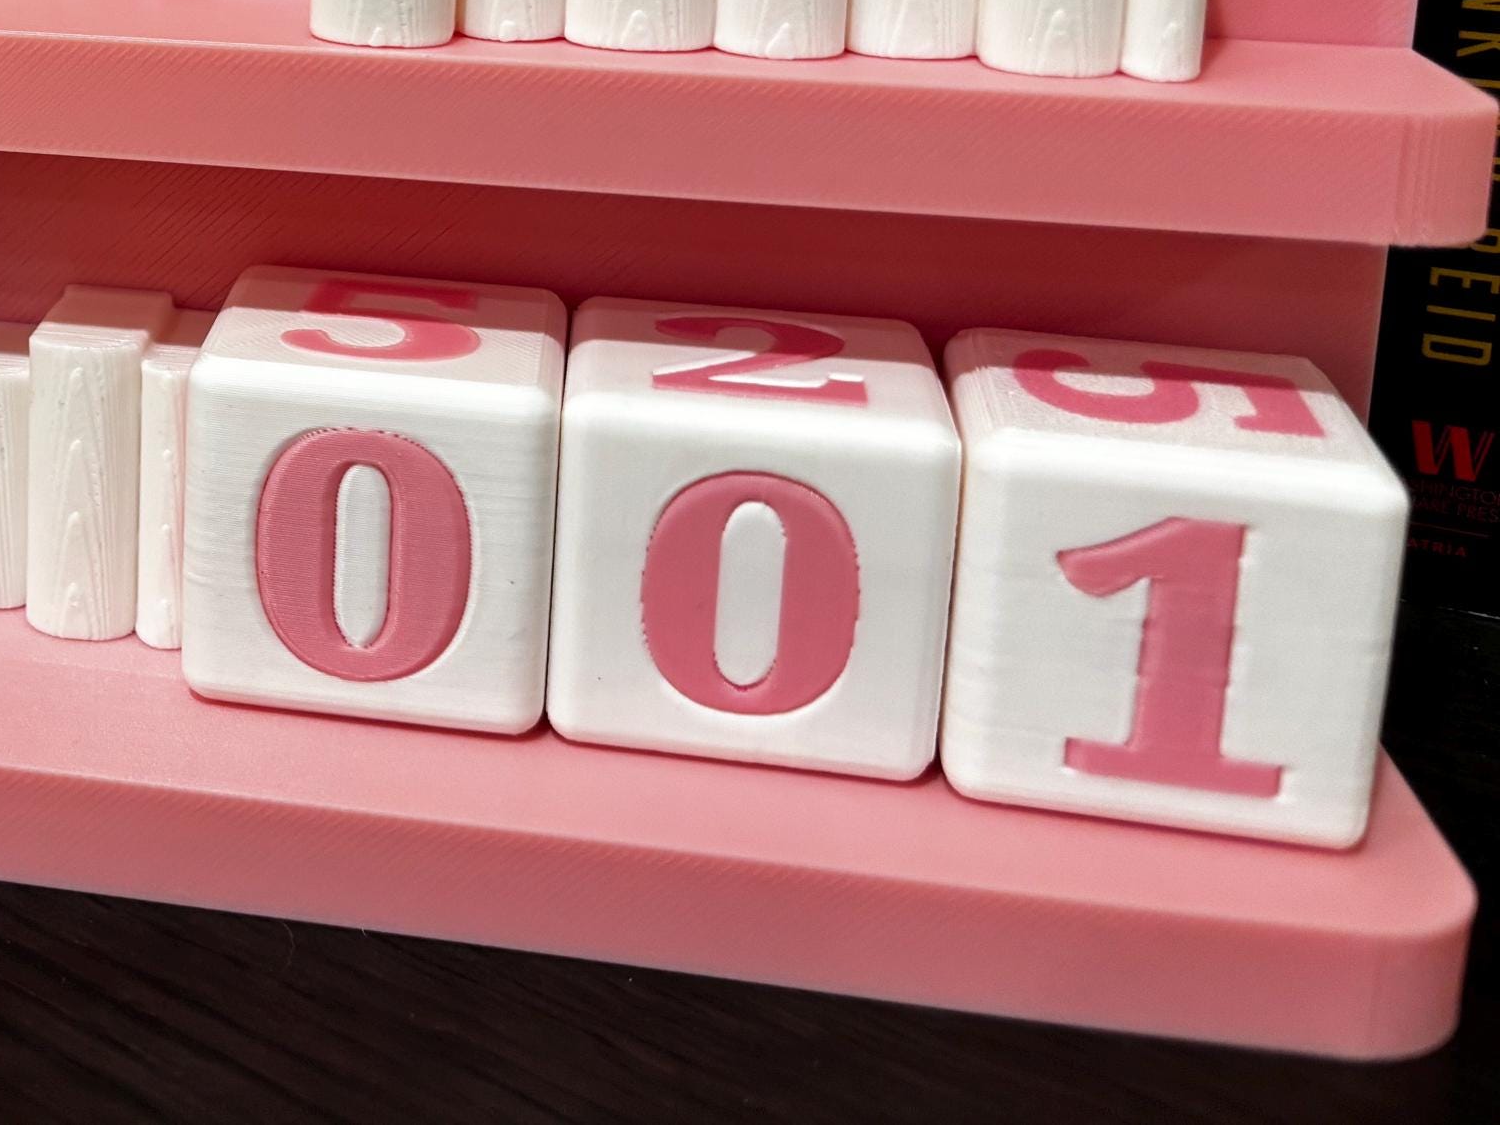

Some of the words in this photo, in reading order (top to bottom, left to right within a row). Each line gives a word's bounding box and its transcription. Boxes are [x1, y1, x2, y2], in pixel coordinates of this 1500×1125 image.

[281, 279, 482, 362] 5
[652, 315, 869, 406] 2
[1012, 348, 1327, 439] 5
